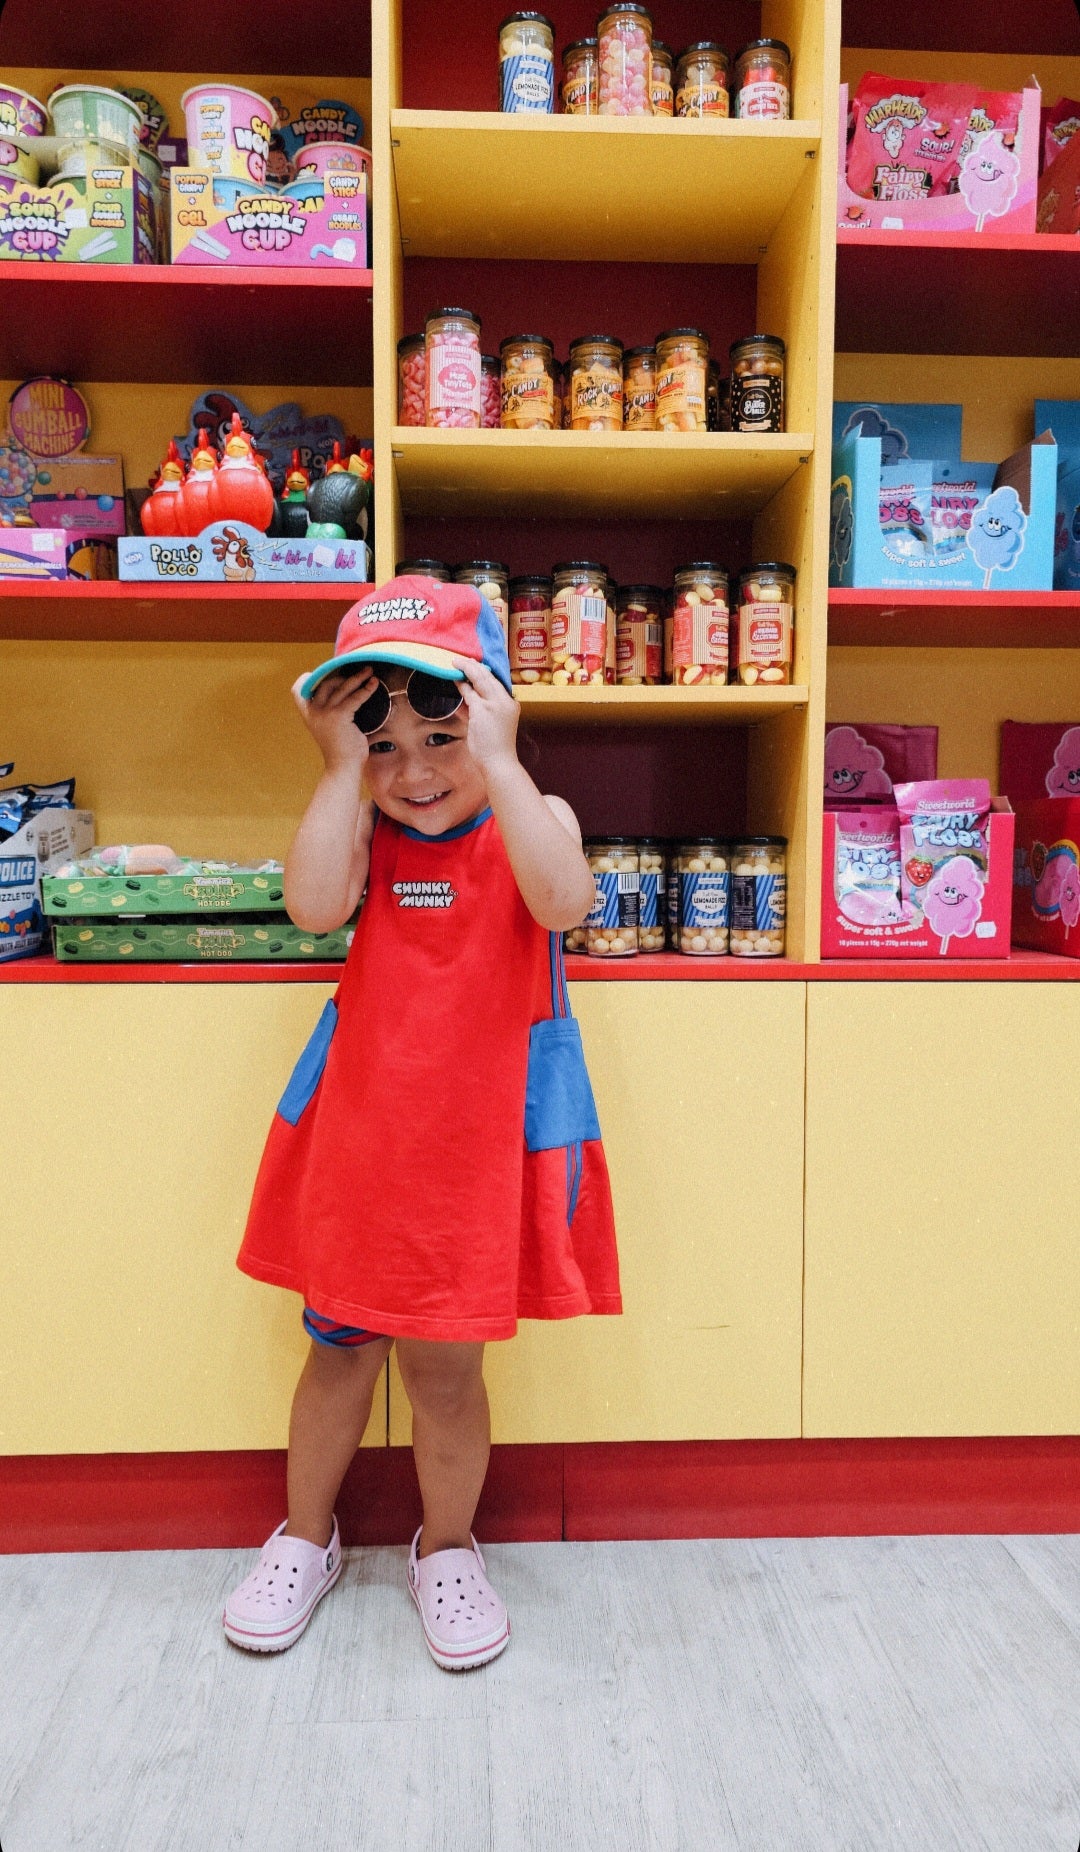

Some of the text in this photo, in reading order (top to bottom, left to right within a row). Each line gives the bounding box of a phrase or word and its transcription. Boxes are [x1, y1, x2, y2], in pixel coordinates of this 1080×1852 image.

[302, 108, 347, 121] CANDY
[865, 100, 924, 128] WARHEADS
[291, 119, 358, 137] NOODLE
[921, 138, 955, 155] SOUR!
[329, 177, 360, 188] CANDY
[875, 166, 925, 187] Fairy
[9, 202, 57, 217] SOUR
[239, 200, 294, 214] CANDY
[226, 213, 307, 235] NOODLE
[12, 230, 58, 251] CUP
[241, 229, 293, 251] CUP
[29, 384, 65, 409] MINI
[511, 379, 539, 397] CANDY
[578, 387, 598, 405] ROCK
[15, 408, 82, 435] GUMBALL
[23, 432, 76, 455] MACHINE
[881, 546, 966, 568] super soft & sweet
[157, 562, 198, 576] LOCO
[358, 597, 427, 617] CHUNKY
[359, 608, 430, 626] MUNKY
[917, 799, 975, 811] Sweetworld
[911, 813, 980, 830] FAIRY
[22, 891, 35, 900] TOY
[392, 882, 451, 895] CHUNKY
[399, 895, 454, 908] MUNKY
[836, 916, 863, 934] super
[863, 927, 883, 935] soft
[884, 927, 893, 935] &
